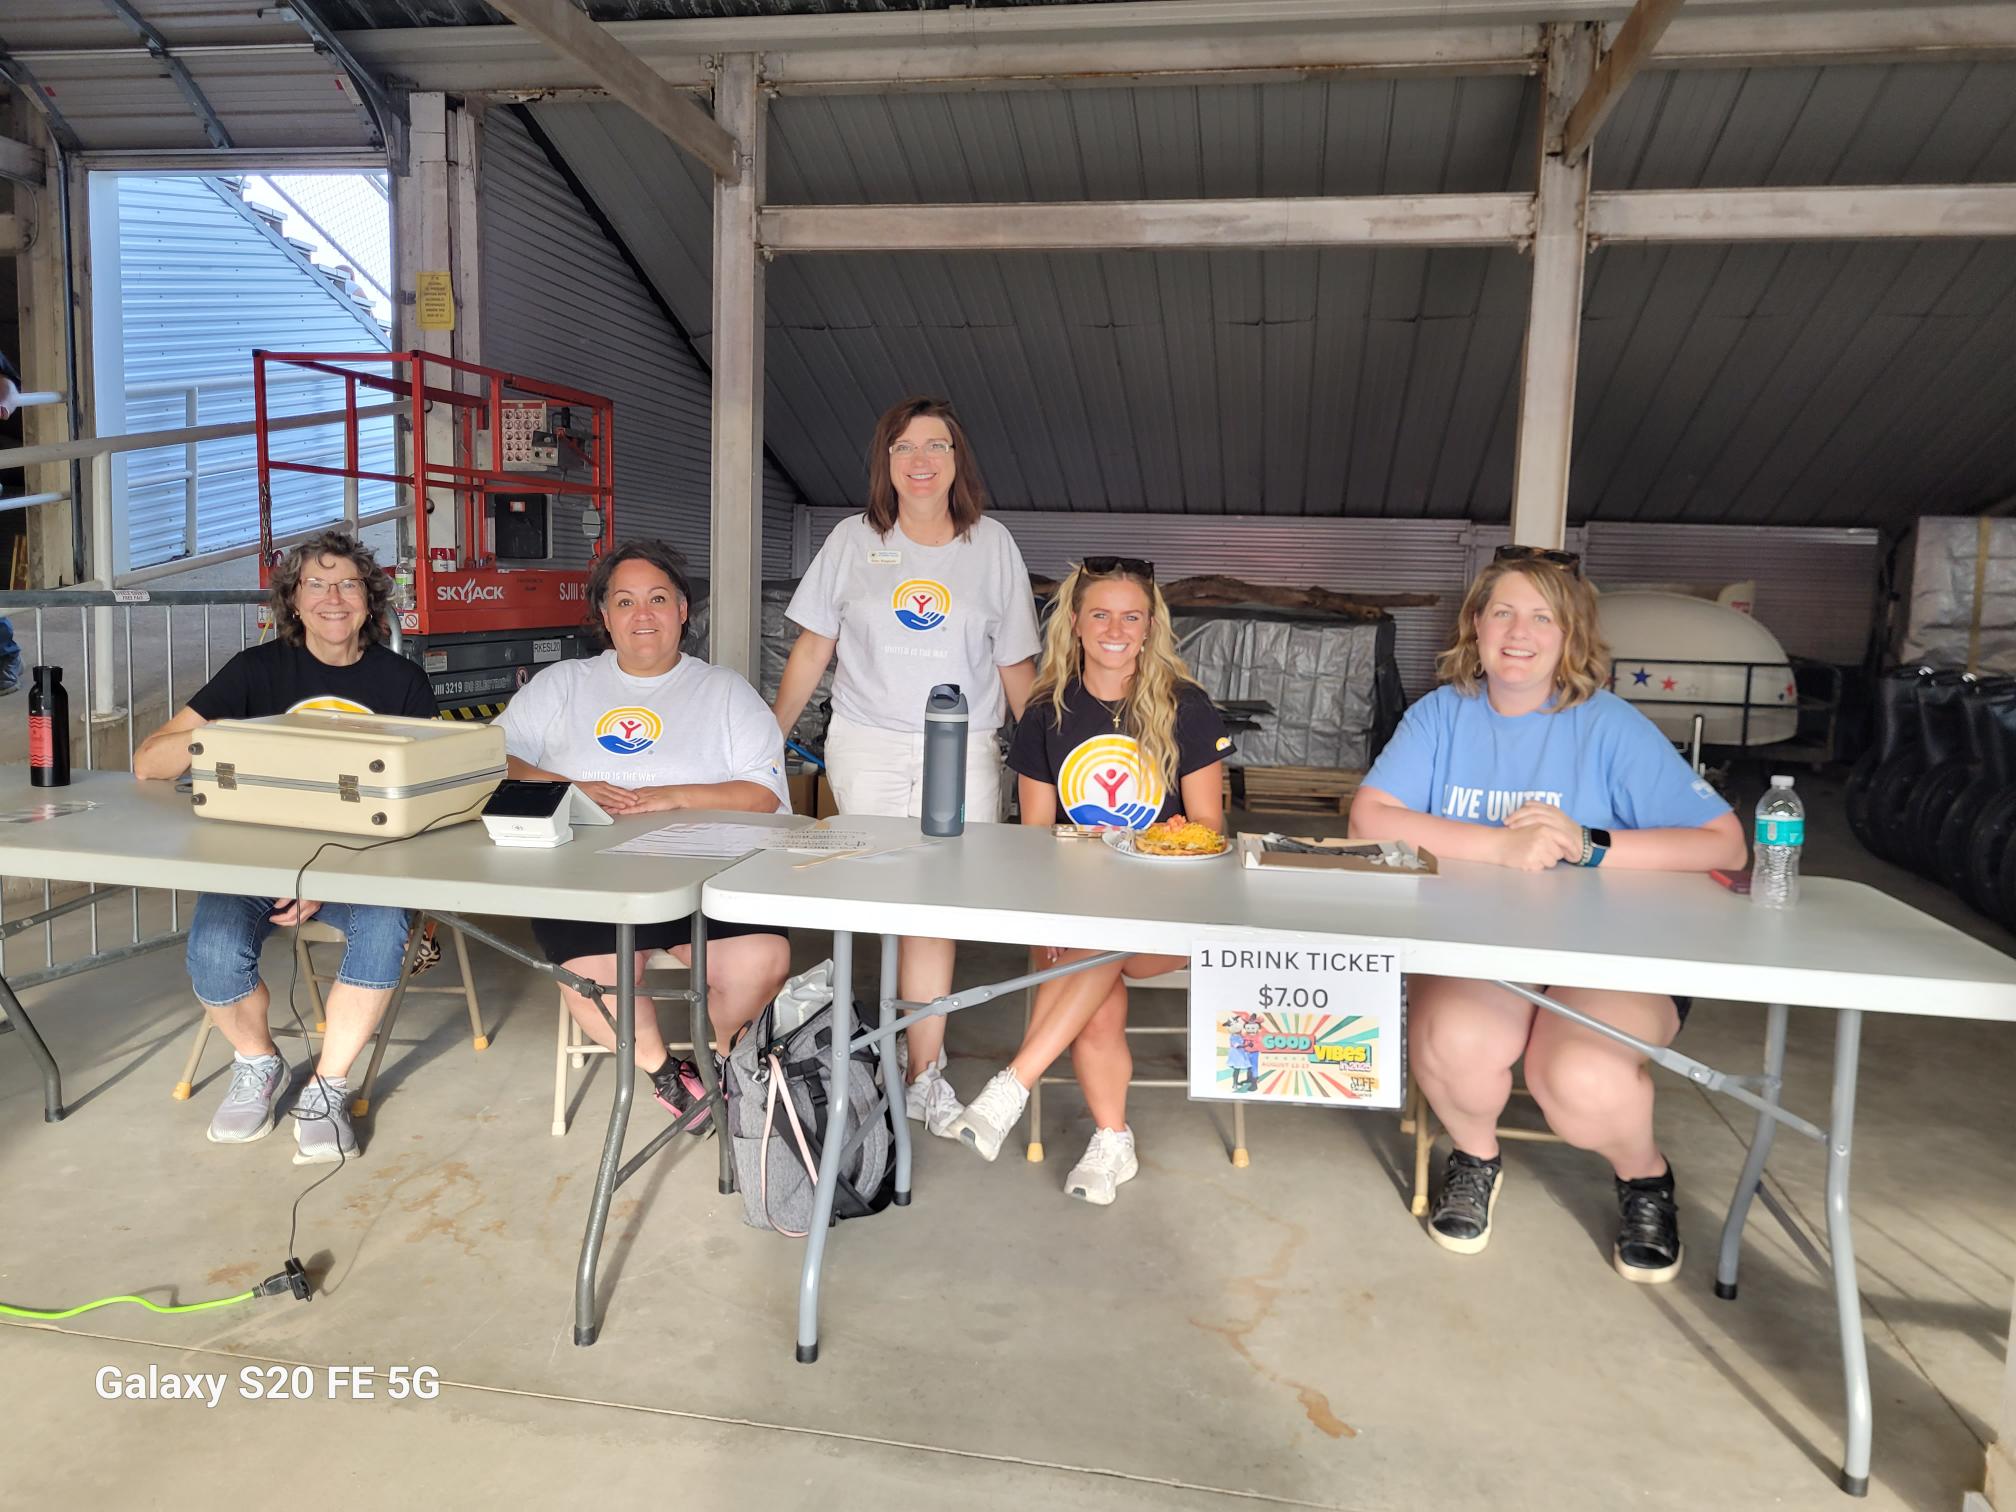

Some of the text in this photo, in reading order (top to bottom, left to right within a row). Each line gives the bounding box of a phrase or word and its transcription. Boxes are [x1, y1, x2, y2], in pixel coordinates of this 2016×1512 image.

[437, 577, 504, 604] SKYJACK
[534, 641, 560, 654] RKESL20
[445, 681, 463, 694] 3219
[1200, 949, 1395, 973] 1 DRINK TICKET
[1258, 984, 1329, 1009] $7.00
[1262, 1035, 1312, 1051] GOOD
